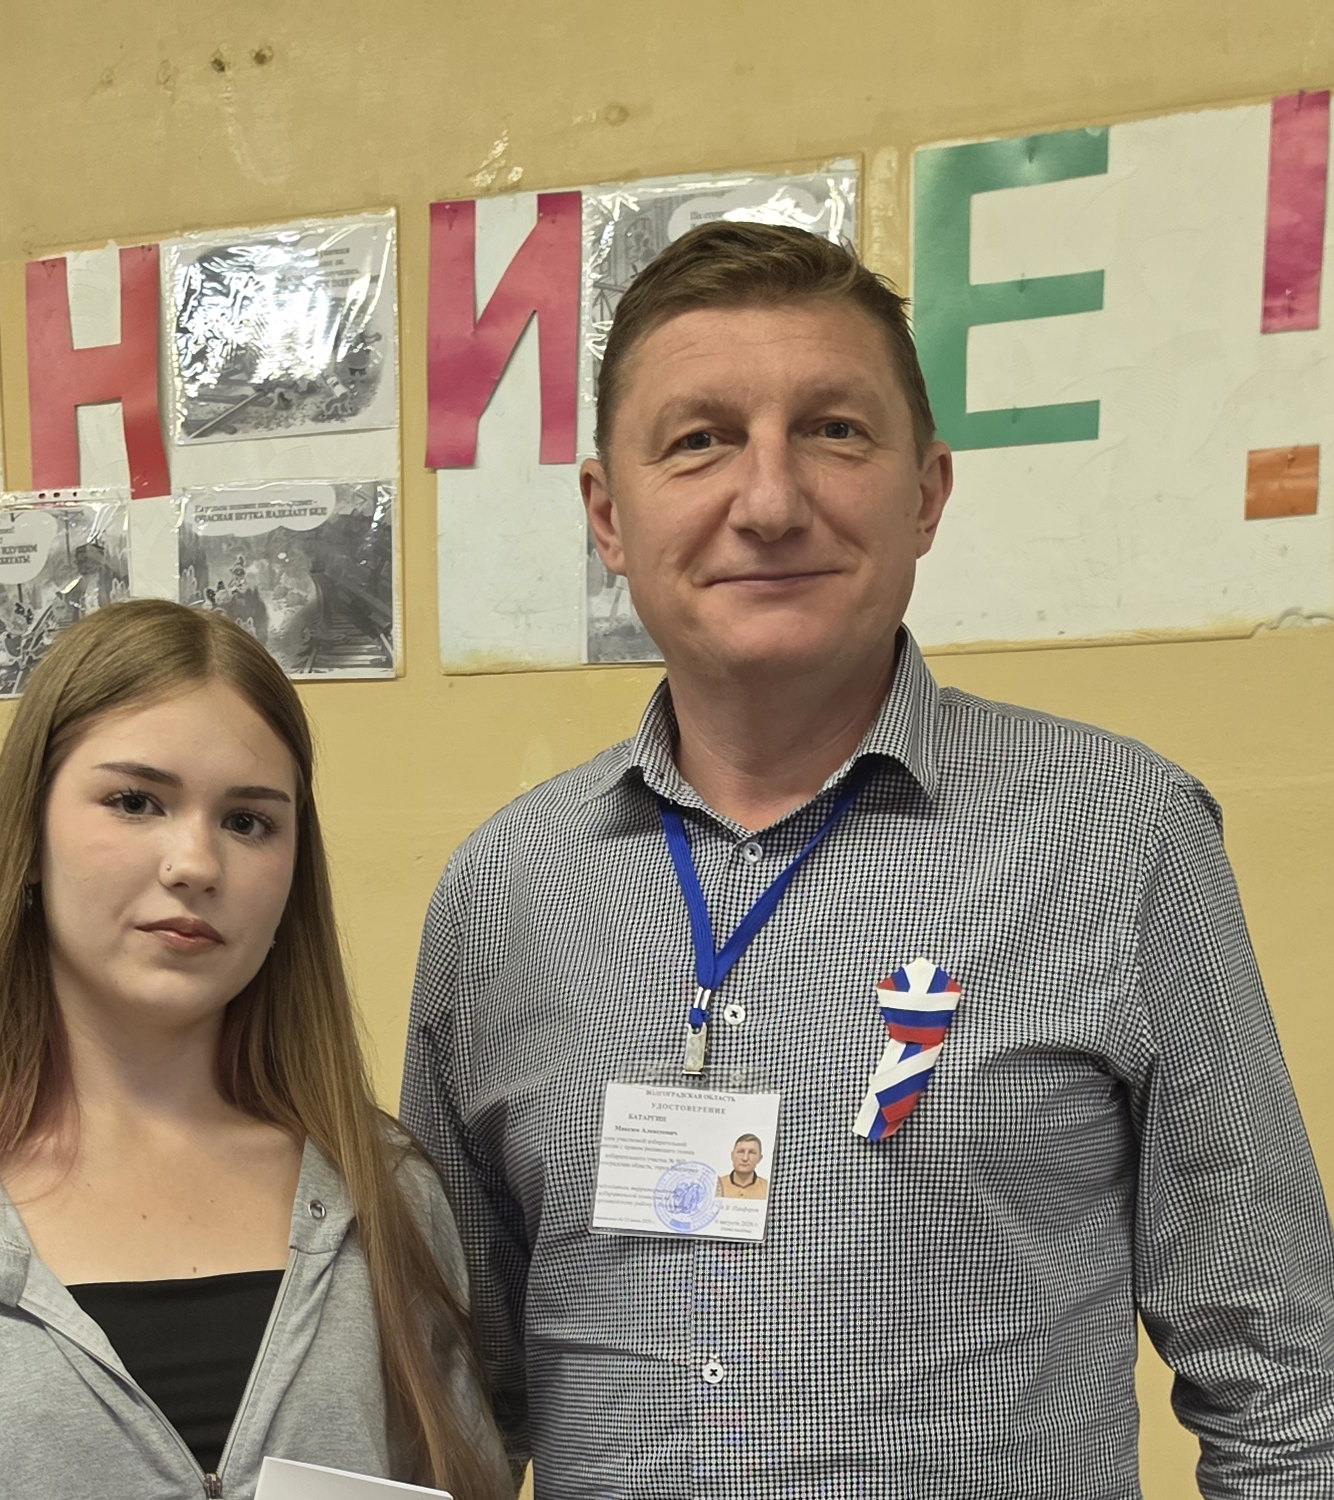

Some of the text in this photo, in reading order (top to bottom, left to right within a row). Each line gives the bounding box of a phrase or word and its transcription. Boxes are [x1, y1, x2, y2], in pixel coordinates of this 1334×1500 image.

[646, 1089, 736, 1102] ВОЛГОГРАДСКАЯ ОБЛАСТЬ
[651, 1102, 727, 1115] УДОСТОВЕРЕНИЕ
